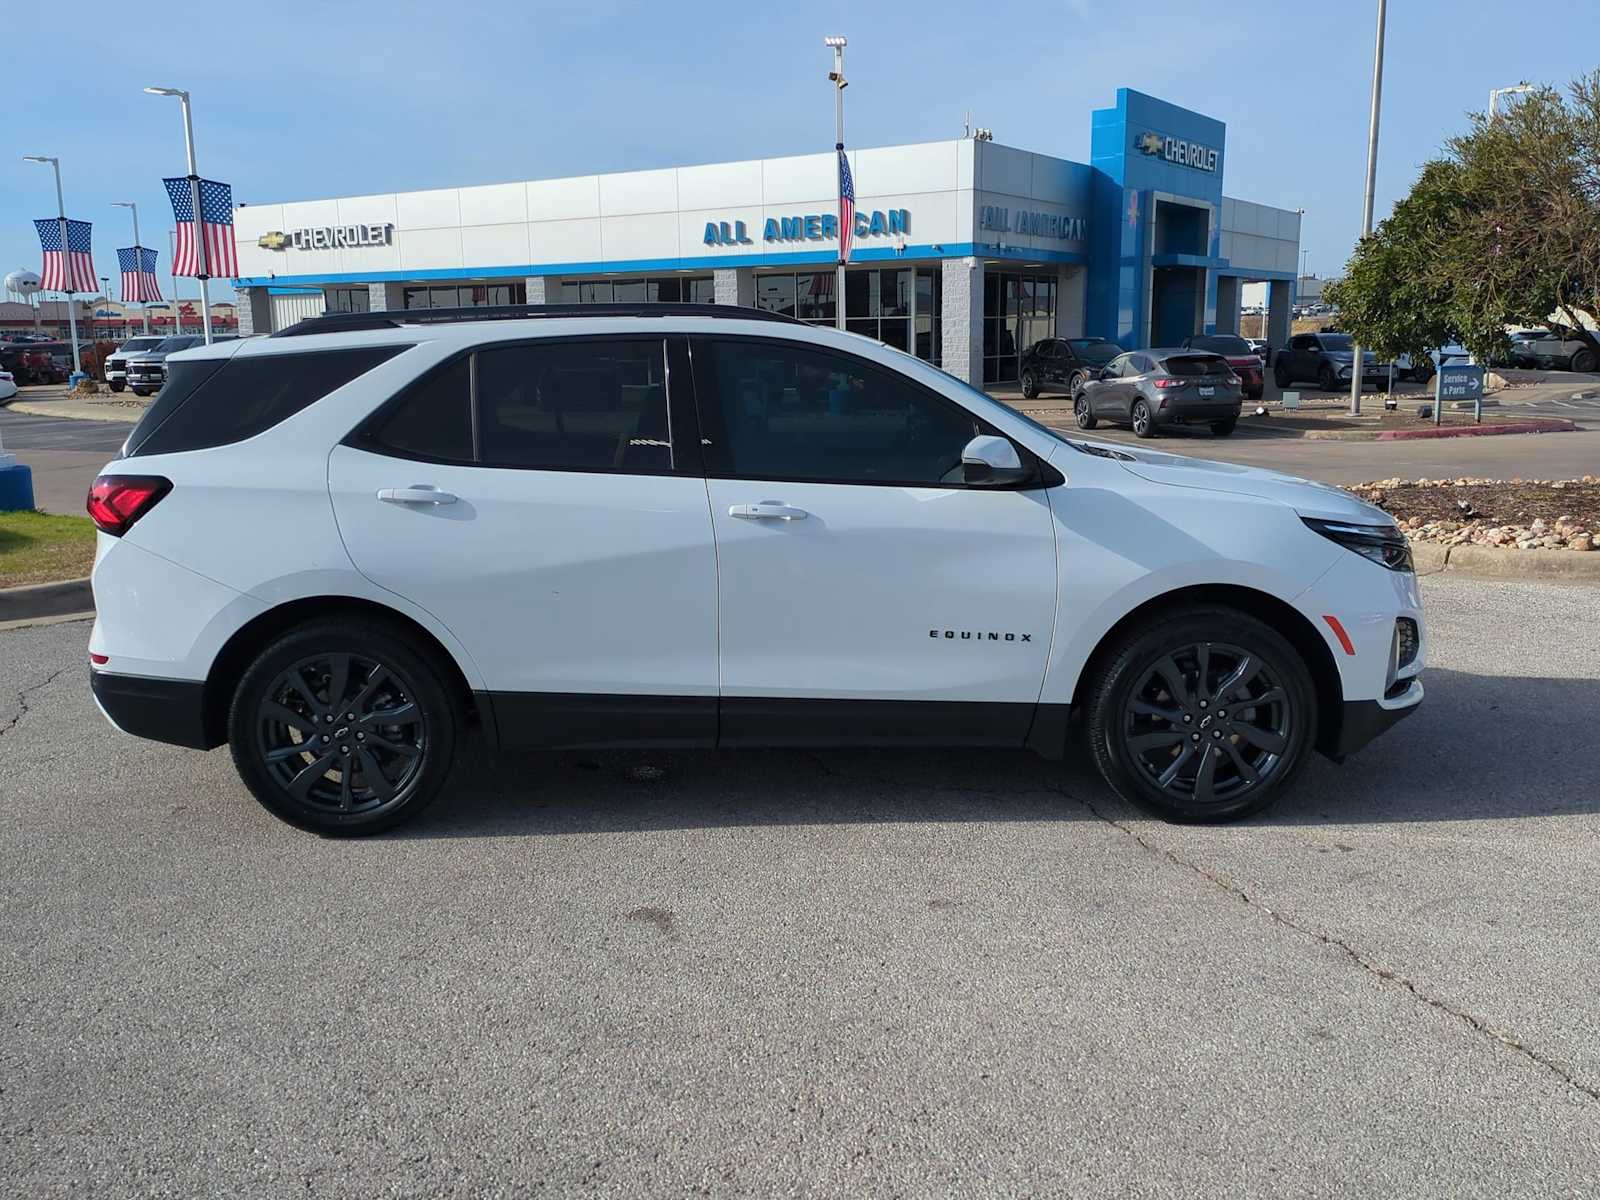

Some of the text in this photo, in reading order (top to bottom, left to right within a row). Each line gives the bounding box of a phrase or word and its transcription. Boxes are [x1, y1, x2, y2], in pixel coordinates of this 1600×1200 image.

[1165, 136, 1219, 172] CHEVROLET
[291, 222, 393, 250] CHEVROLET
[703, 208, 910, 246] ALL AMERCAN
[980, 205, 1089, 241] ALL AMERICAN
[1443, 374, 1468, 383] Service
[1449, 386, 1466, 395] Parts
[928, 629, 1032, 643] EQUINOX
